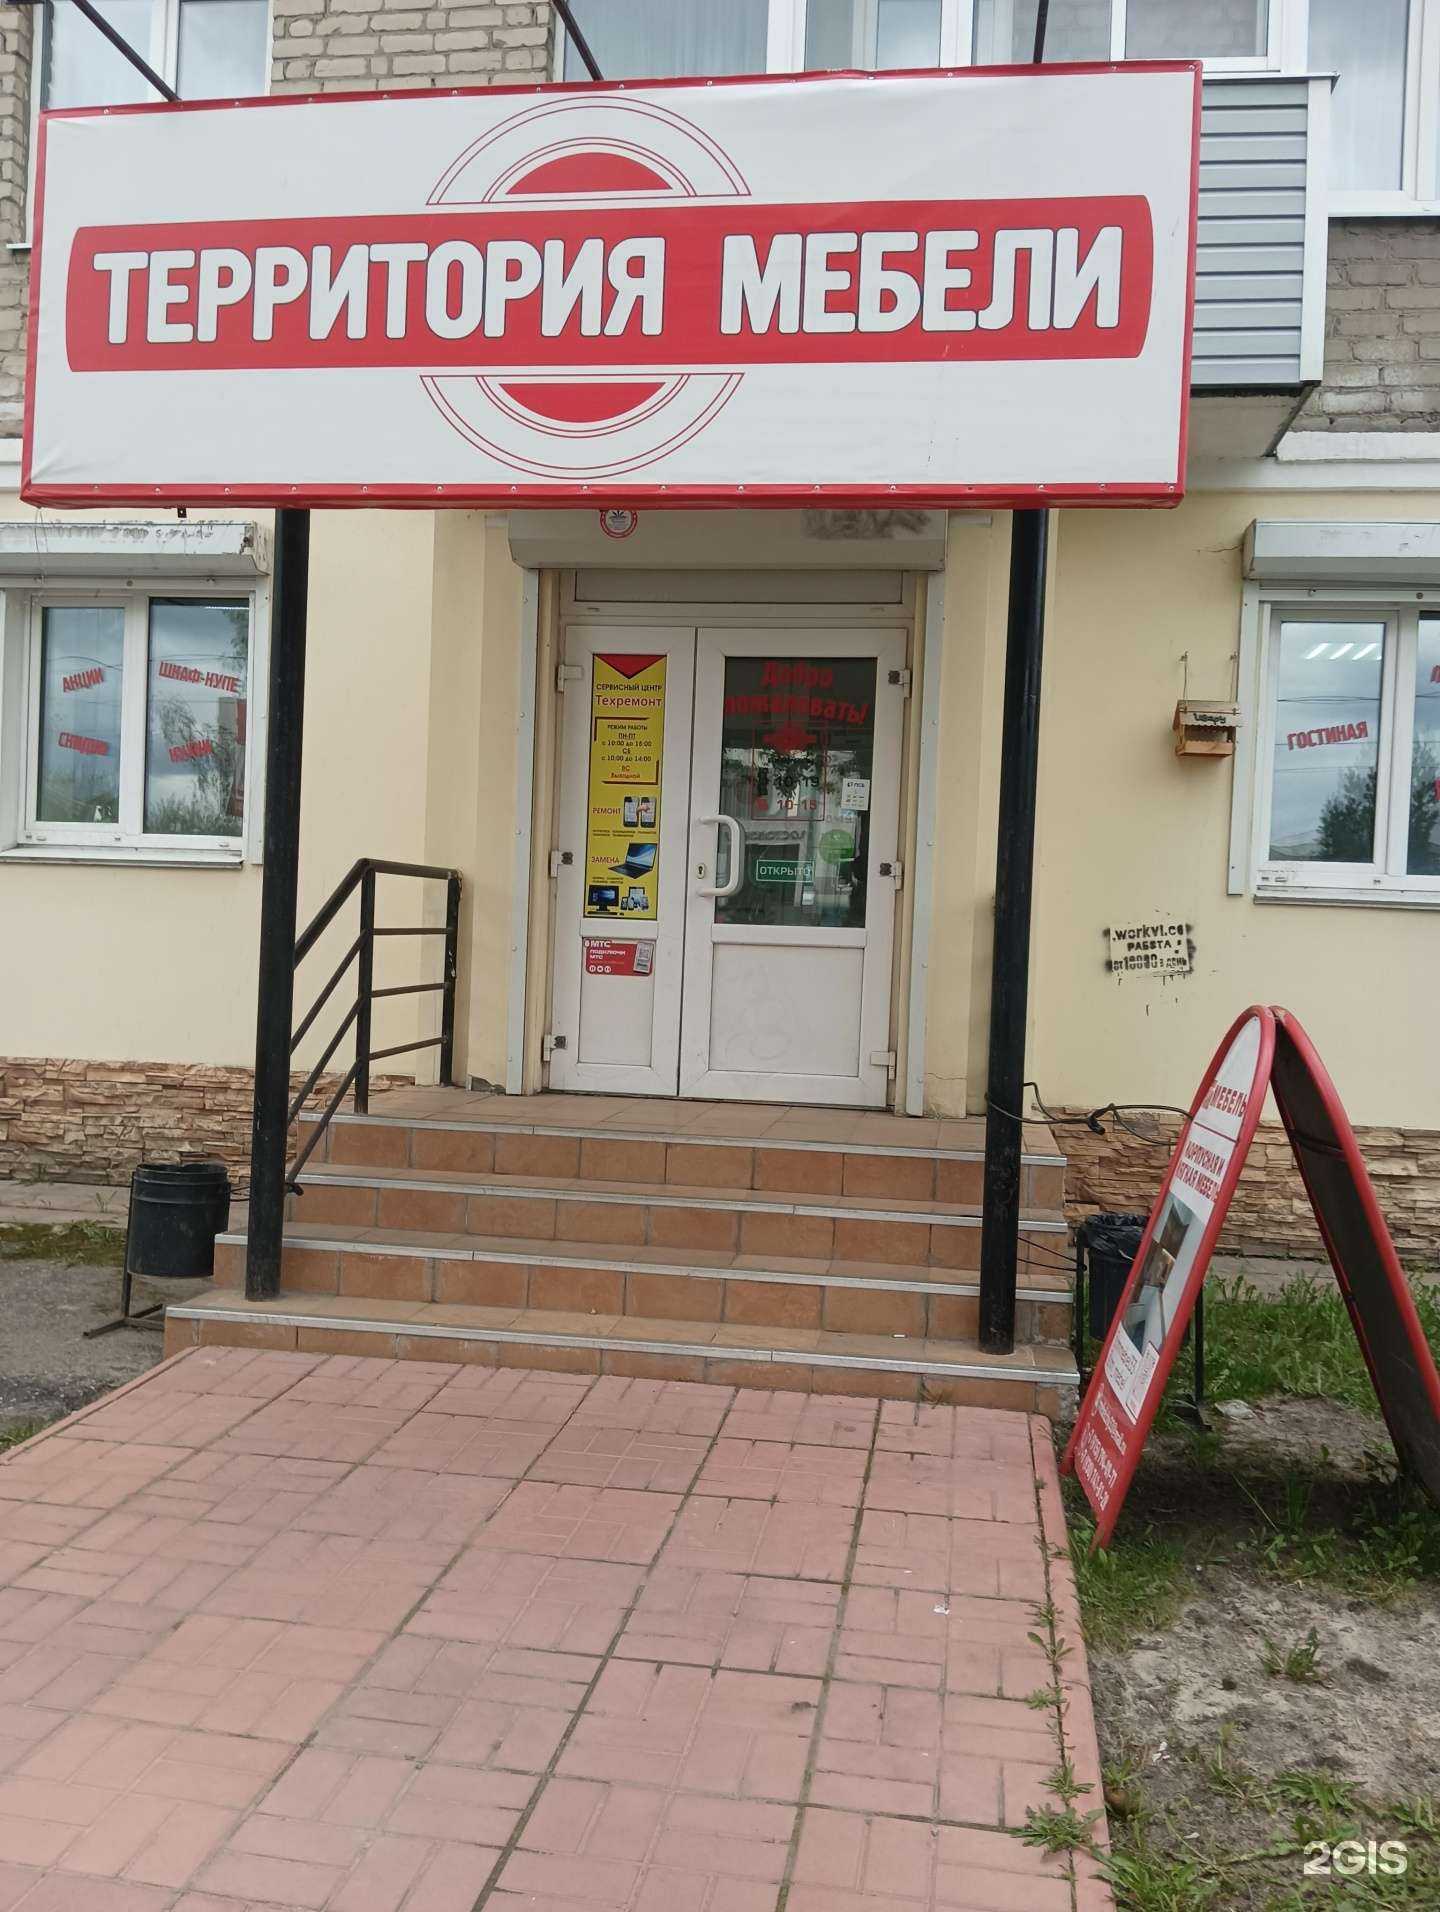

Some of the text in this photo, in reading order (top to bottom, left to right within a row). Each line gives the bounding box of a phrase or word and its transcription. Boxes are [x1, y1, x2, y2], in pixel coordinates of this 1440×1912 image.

[93, 226, 1123, 344] ТЕРРИТОРИЯ МЕБЕЛИ
[596, 683, 663, 693] СЕРВИСНЫЙ ЦЕНТР
[595, 694, 663, 709] Техремонт
[1287, 721, 1369, 750] ГОСТИНАЯ
[592, 807, 621, 815] РЕМОНТ
[591, 856, 620, 864] ЗАМЕНА
[760, 866, 811, 876] ОТКРЫТО
[590, 940, 611, 948] МТС
